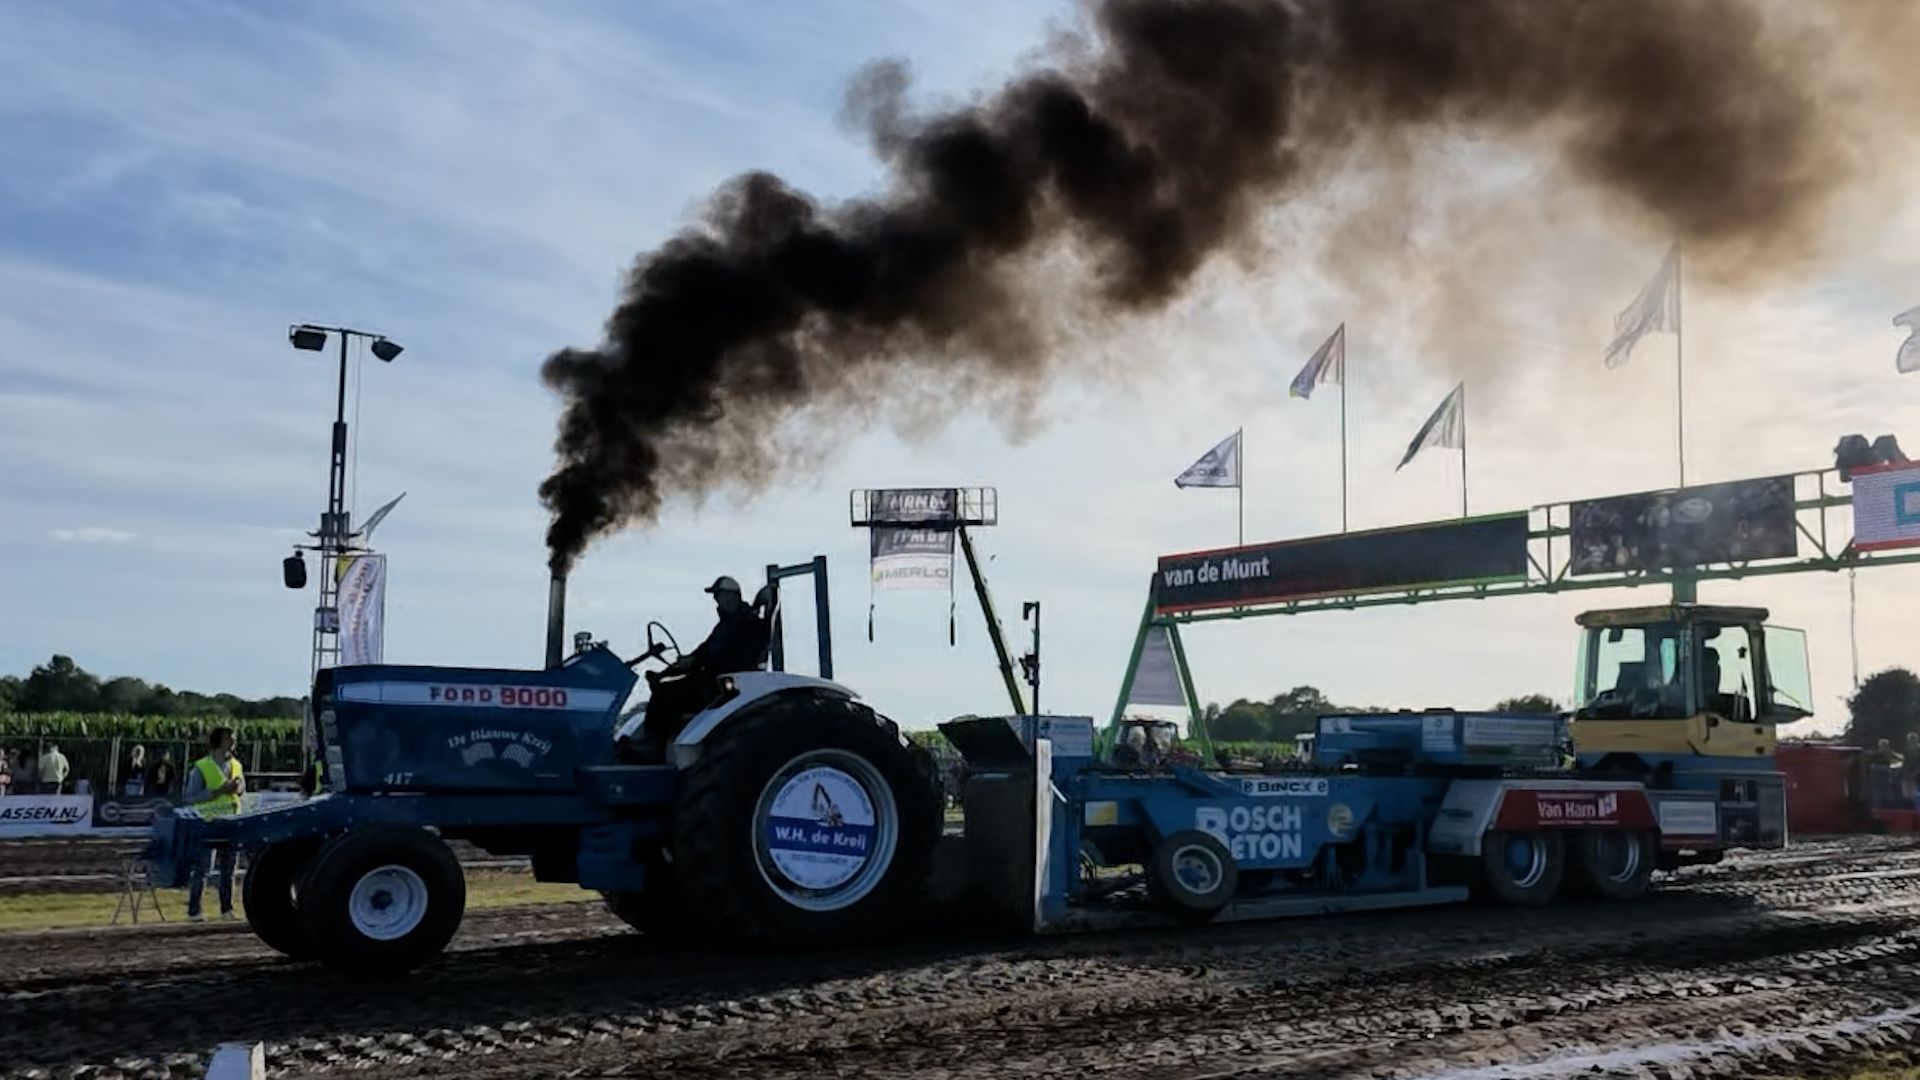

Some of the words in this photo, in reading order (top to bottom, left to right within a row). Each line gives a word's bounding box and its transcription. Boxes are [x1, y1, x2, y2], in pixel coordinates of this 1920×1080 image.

[885, 567, 949, 579] MERLO
[1164, 568, 1194, 587] van
[1197, 561, 1219, 582] de
[1222, 557, 1270, 580] Munt
[430, 686, 493, 702] FORD
[501, 687, 568, 707] 9000
[384, 772, 413, 785] 417
[1, 807, 79, 820] ASSEN.NL
[1537, 801, 1562, 818] Van
[775, 826, 807, 843] W.H.
[811, 829, 829, 845] de
[833, 832, 866, 851] Kreij
